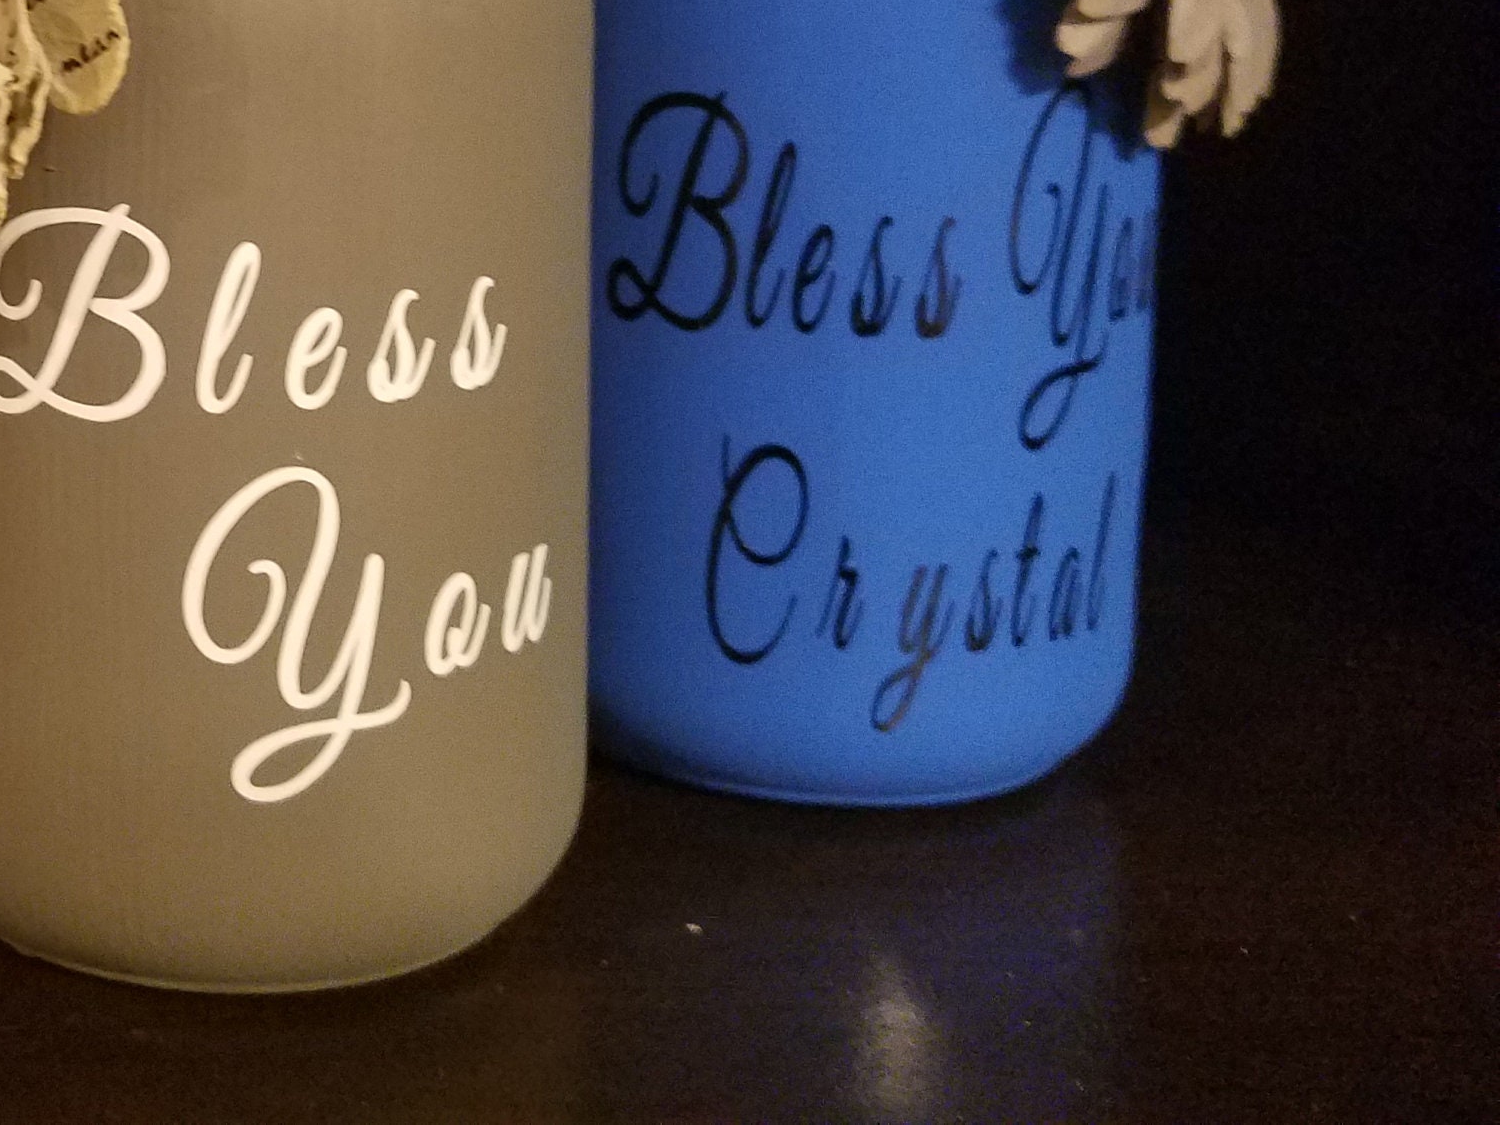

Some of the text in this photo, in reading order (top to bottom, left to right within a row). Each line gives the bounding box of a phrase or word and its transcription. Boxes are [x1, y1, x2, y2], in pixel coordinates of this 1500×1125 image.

[606, 91, 963, 338] Bless
[181, 465, 553, 802] You
[705, 435, 1117, 732] Crystal
